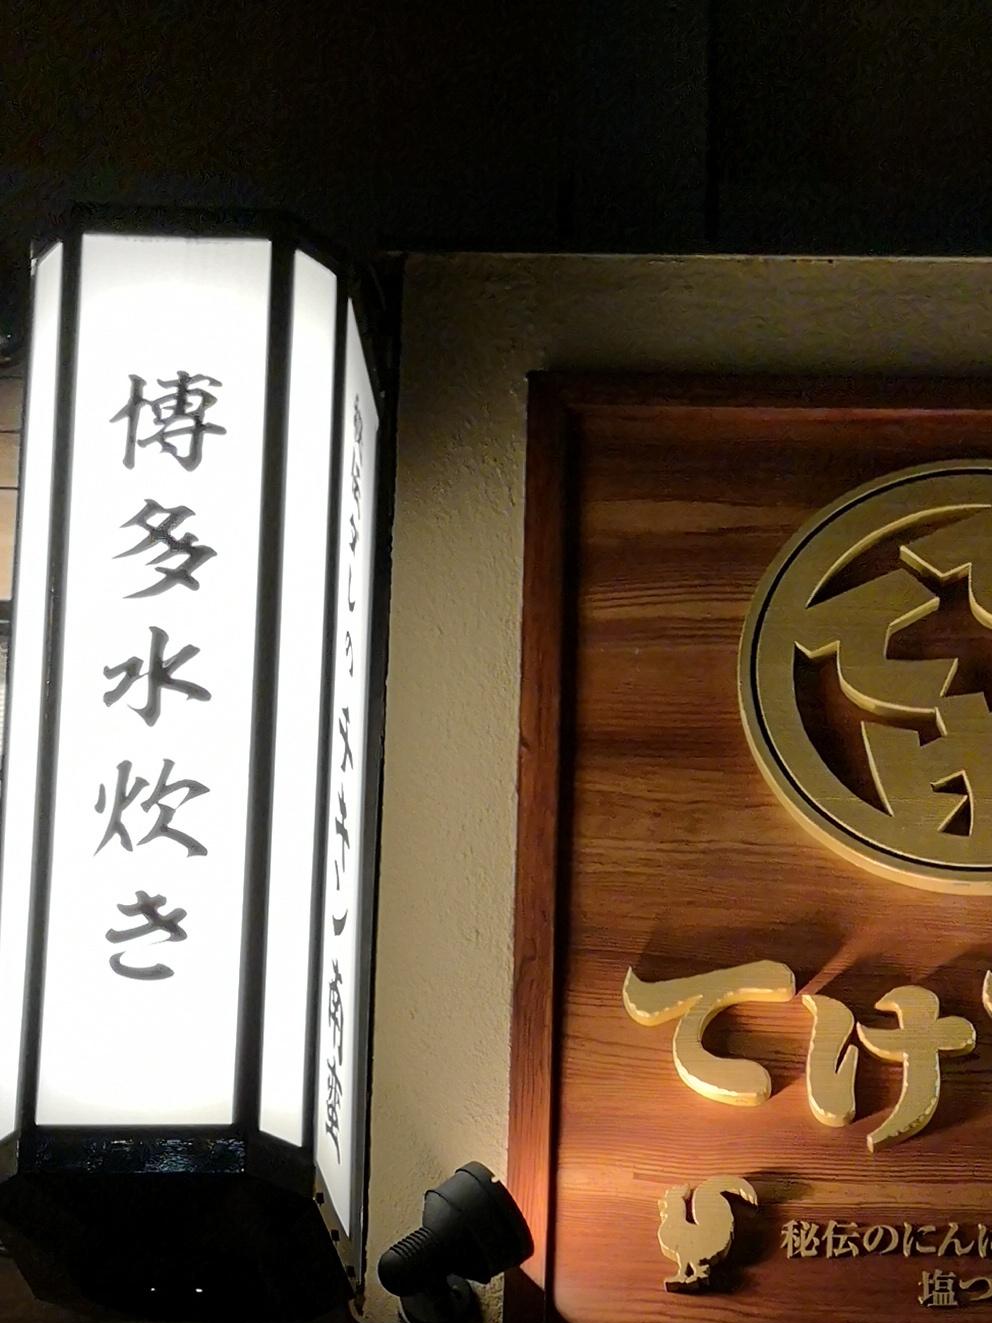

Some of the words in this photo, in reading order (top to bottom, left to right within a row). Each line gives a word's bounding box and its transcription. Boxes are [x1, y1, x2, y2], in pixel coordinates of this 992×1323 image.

[93, 369, 228, 983] 博多水炊き
